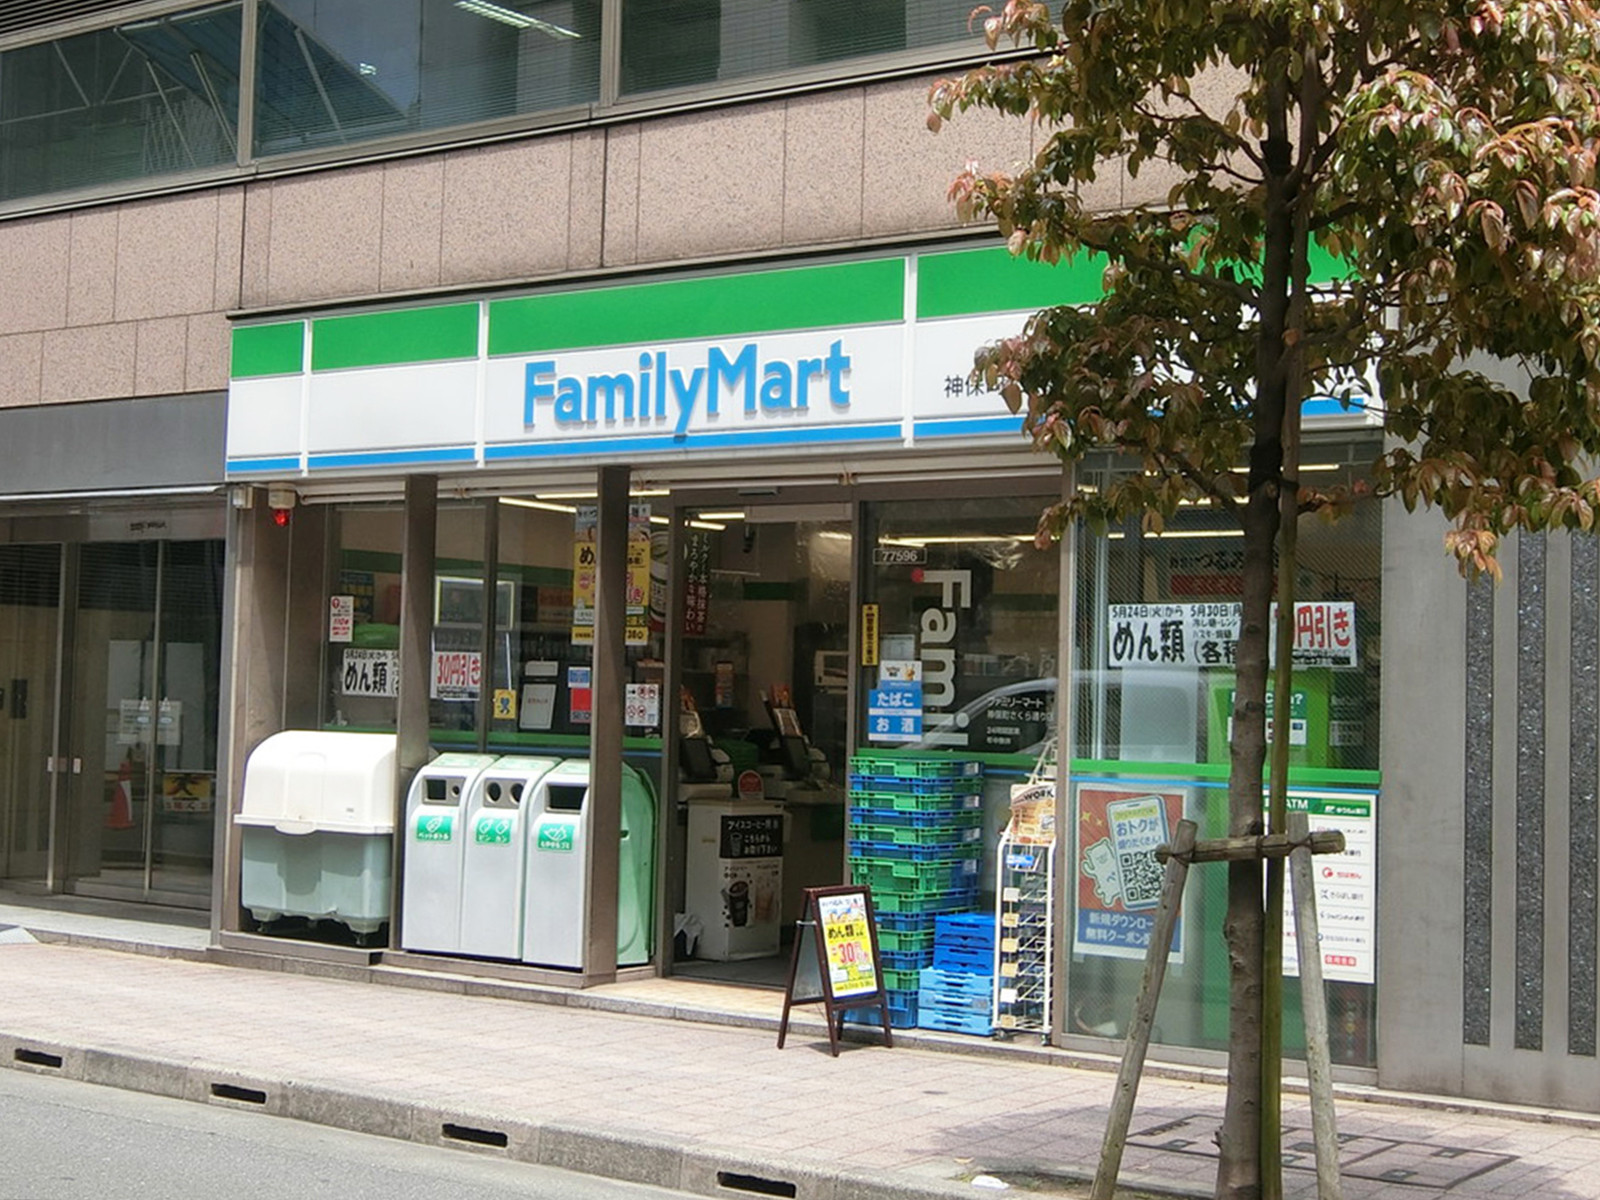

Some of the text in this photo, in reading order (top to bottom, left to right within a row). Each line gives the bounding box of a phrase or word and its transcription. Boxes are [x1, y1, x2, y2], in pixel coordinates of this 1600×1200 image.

[523, 339, 852, 441] FamilyMart
[882, 551, 917, 562] 77596
[1275, 605, 1350, 649] 円引き
[1113, 619, 1185, 663] めん類
[344, 661, 388, 693] めん類
[877, 692, 914, 707] たばこ
[988, 696, 1044, 708] ファミリーマート
[876, 718, 915, 732] お酒
[1116, 819, 1159, 837] おトクが
